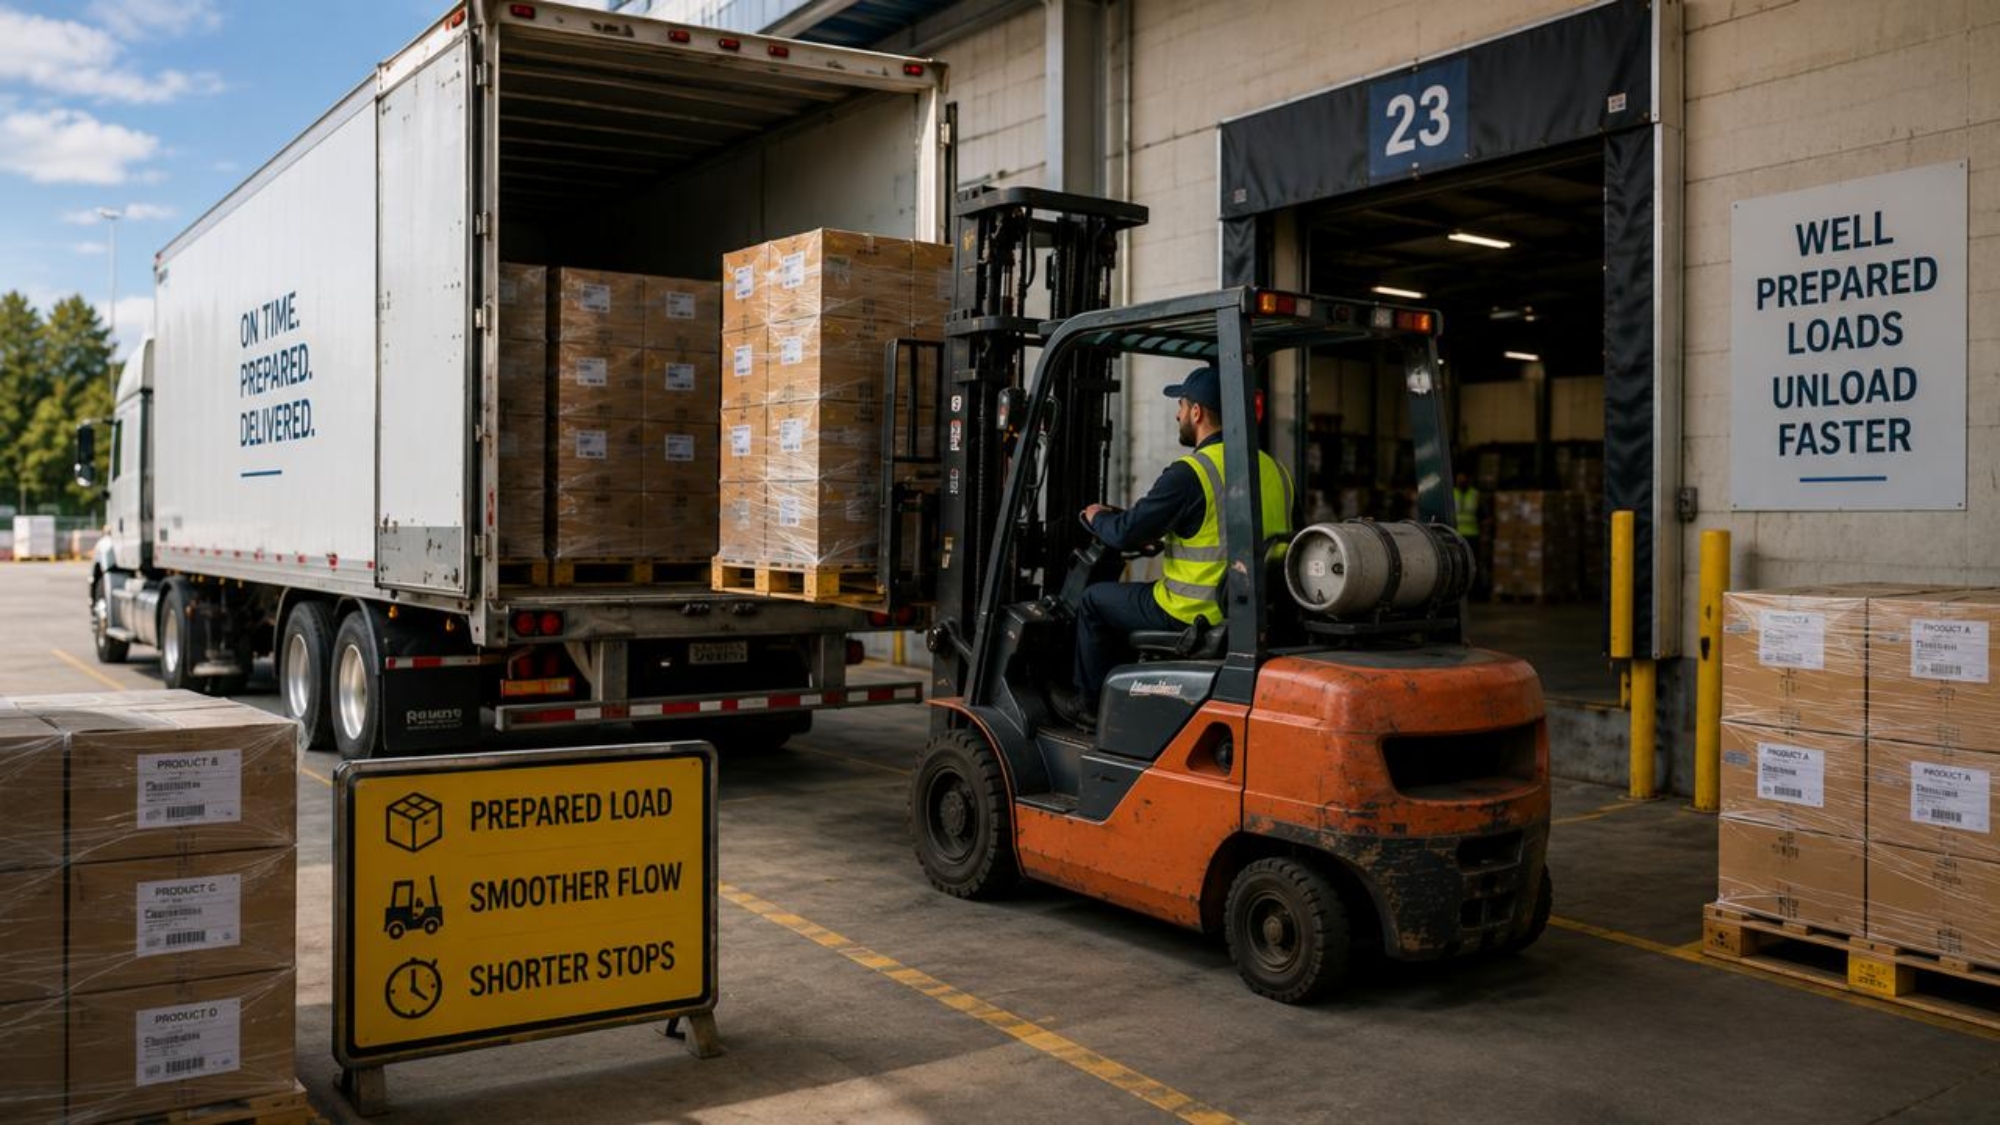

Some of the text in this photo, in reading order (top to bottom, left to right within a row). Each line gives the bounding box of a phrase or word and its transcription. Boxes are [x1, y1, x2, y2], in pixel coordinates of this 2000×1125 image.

[1384, 84, 1451, 157] 23
[1795, 211, 1894, 257] WELL
[1756, 256, 1938, 311] PREPARED
[240, 290, 300, 349] ON TIME.
[1787, 310, 1904, 355] LOADS
[240, 342, 313, 399] PREPARED.
[1772, 366, 1918, 409] UNLOAD
[240, 398, 315, 447] DELIVERED.
[1778, 417, 1912, 456] FASTER
[157, 757, 208, 770] PRODUCT
[470, 787, 673, 831] PREPARED LOAD
[155, 884, 206, 897] PRODUCT
[469, 861, 683, 913] SMOOTHER FLOW
[469, 940, 676, 997] SHORTER STOPS
[155, 1008, 207, 1024] PRODUCT
